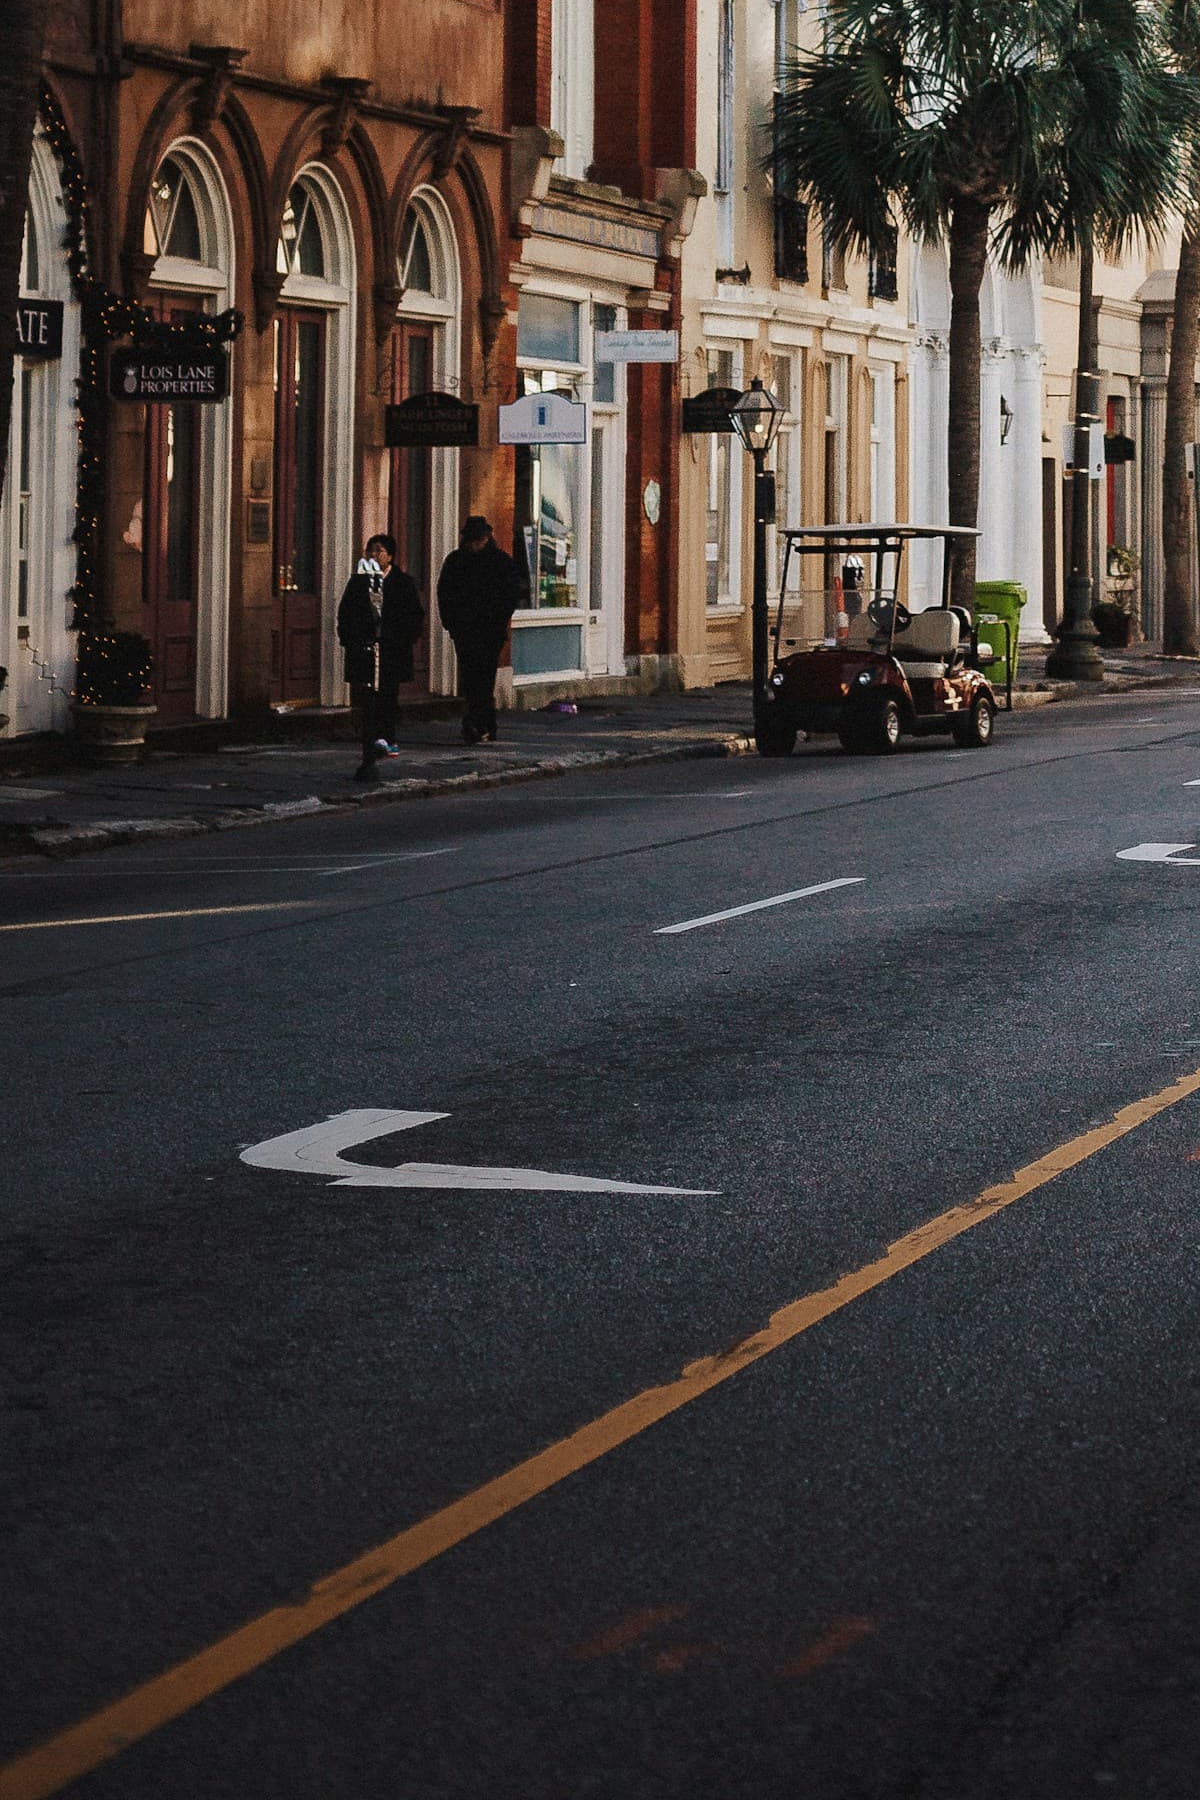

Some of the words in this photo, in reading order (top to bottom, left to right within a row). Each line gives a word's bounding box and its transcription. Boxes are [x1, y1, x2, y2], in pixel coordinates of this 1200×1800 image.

[141, 364, 173, 379] LOIS
[178, 364, 215, 379] LANE
[140, 380, 215, 394] PROPERTIES
